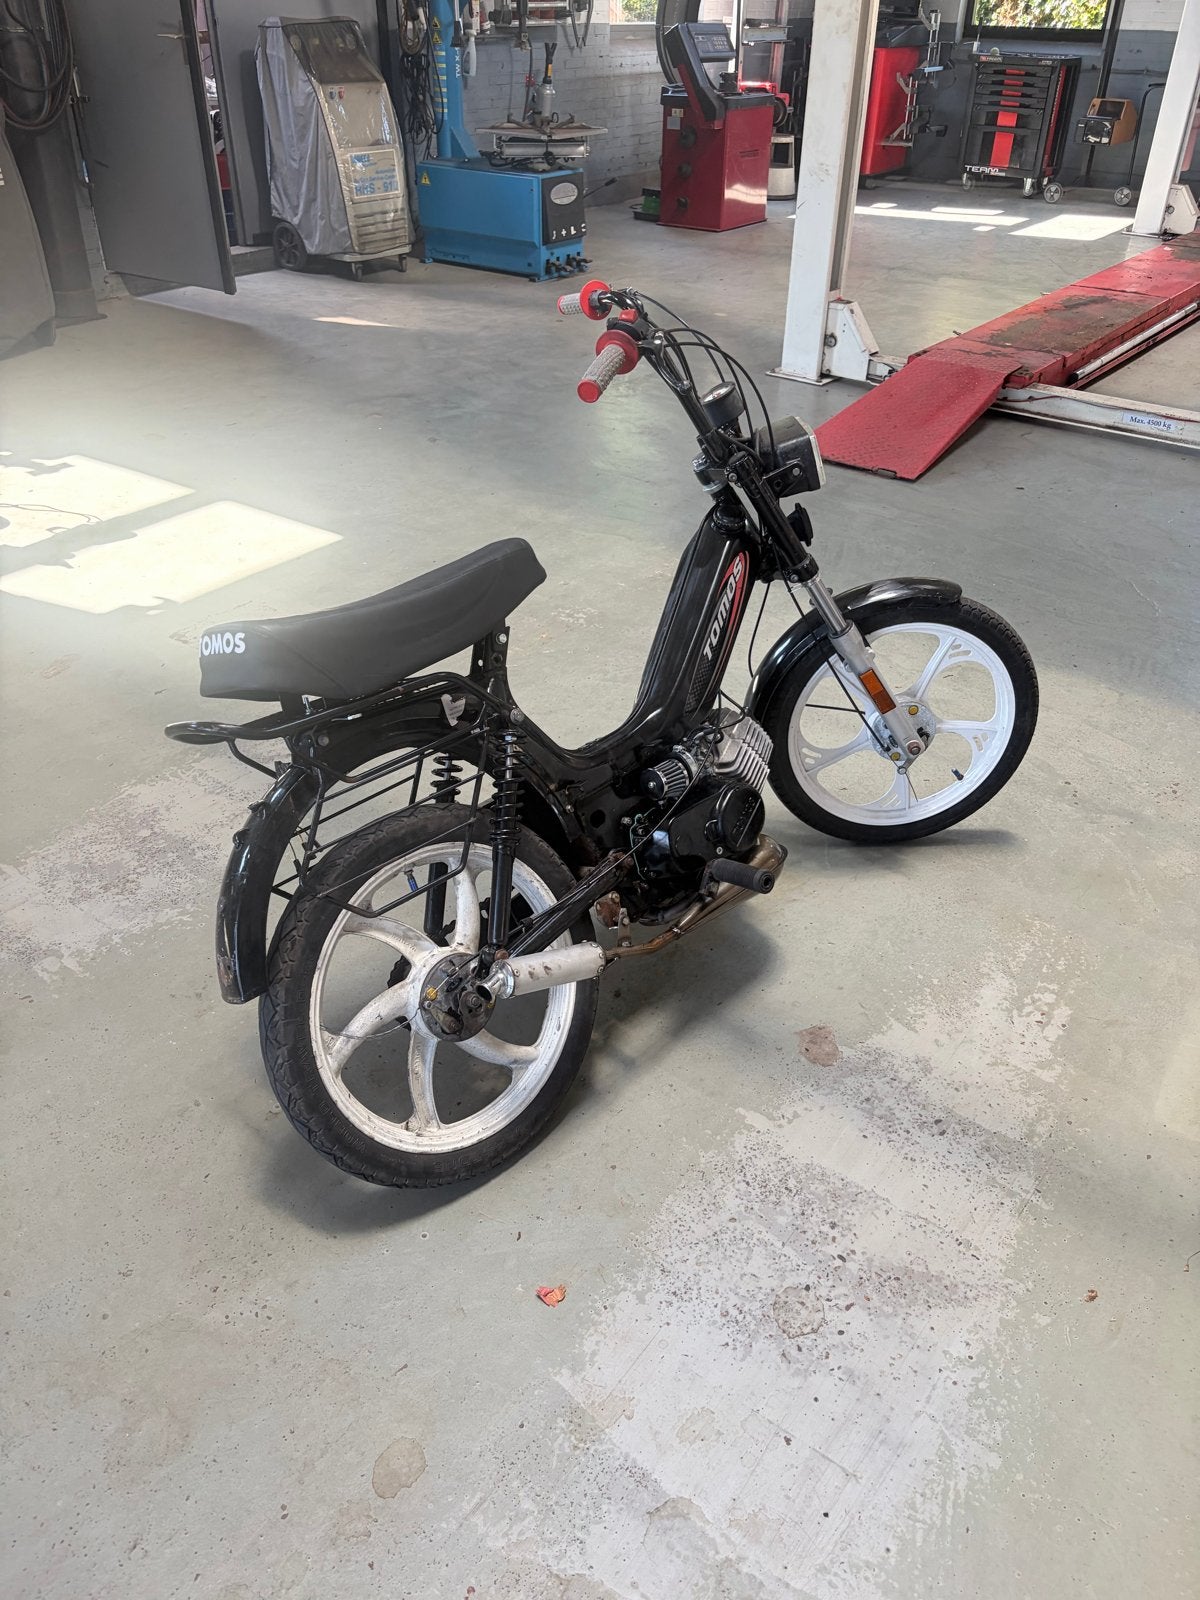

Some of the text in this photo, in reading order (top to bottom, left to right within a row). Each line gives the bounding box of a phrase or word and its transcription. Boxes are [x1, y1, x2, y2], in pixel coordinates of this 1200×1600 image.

[455, 64, 461, 78] TW
[965, 165, 999, 174] TEAM
[1130, 416, 1172, 430] Max. 4500 kg
[703, 555, 744, 661] TOMOS
[198, 632, 246, 656] OMOS
